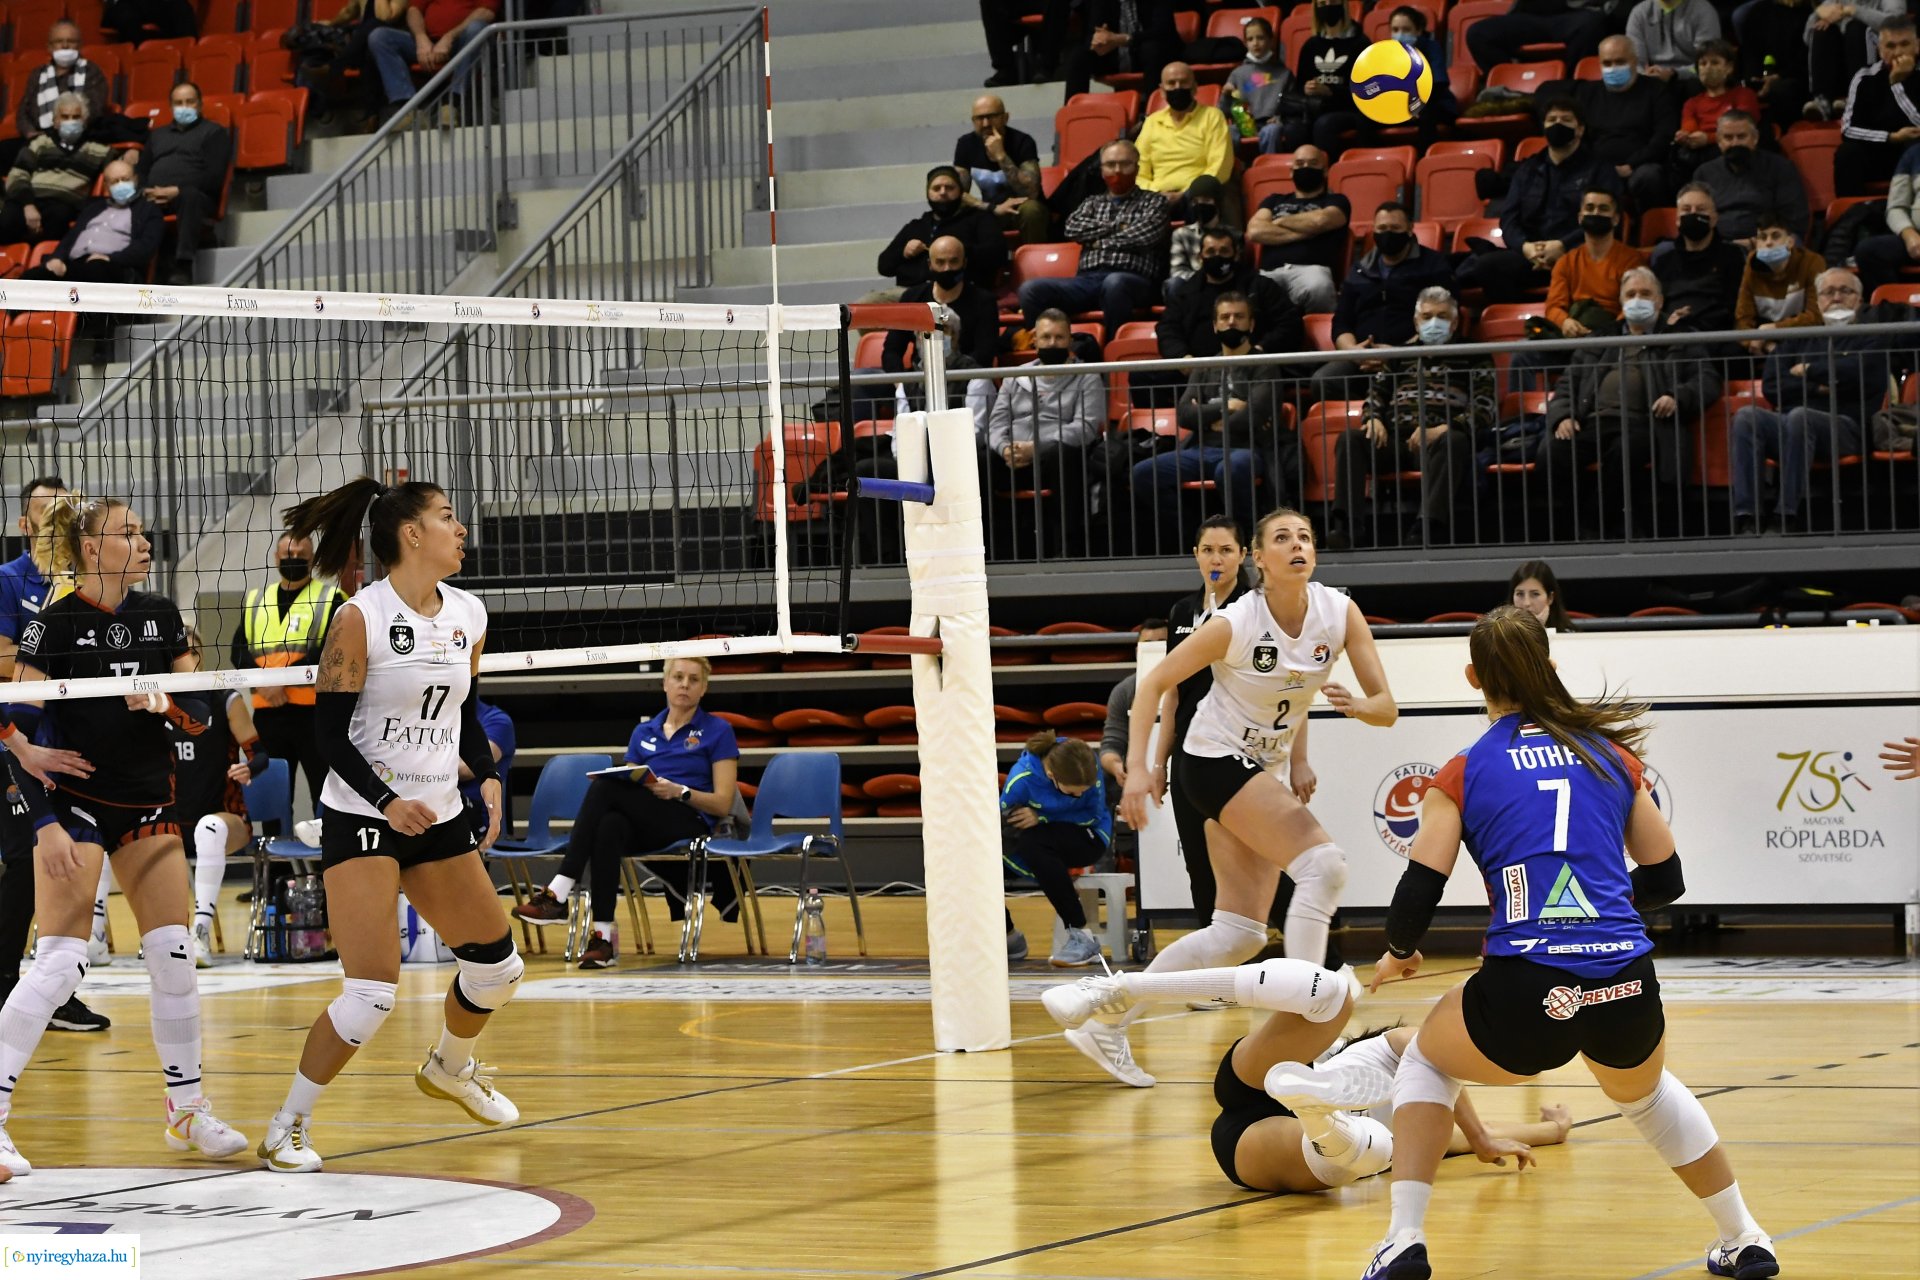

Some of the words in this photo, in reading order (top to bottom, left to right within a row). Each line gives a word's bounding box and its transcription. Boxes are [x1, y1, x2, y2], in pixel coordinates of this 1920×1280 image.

[421, 685, 451, 720] 17
[1273, 699, 1290, 731] 2
[379, 716, 455, 745] FATUM
[175, 741, 195, 760] 18
[1506, 745, 1564, 771] TÓTH
[1536, 778, 1571, 852] 7
[1803, 816, 1845, 826] MAGYAR
[357, 827, 381, 851] 17
[1766, 826, 1885, 849] RÖPLABDA
[1510, 868, 1522, 919] STRABAG
[1547, 941, 1634, 954] BESTRONG
